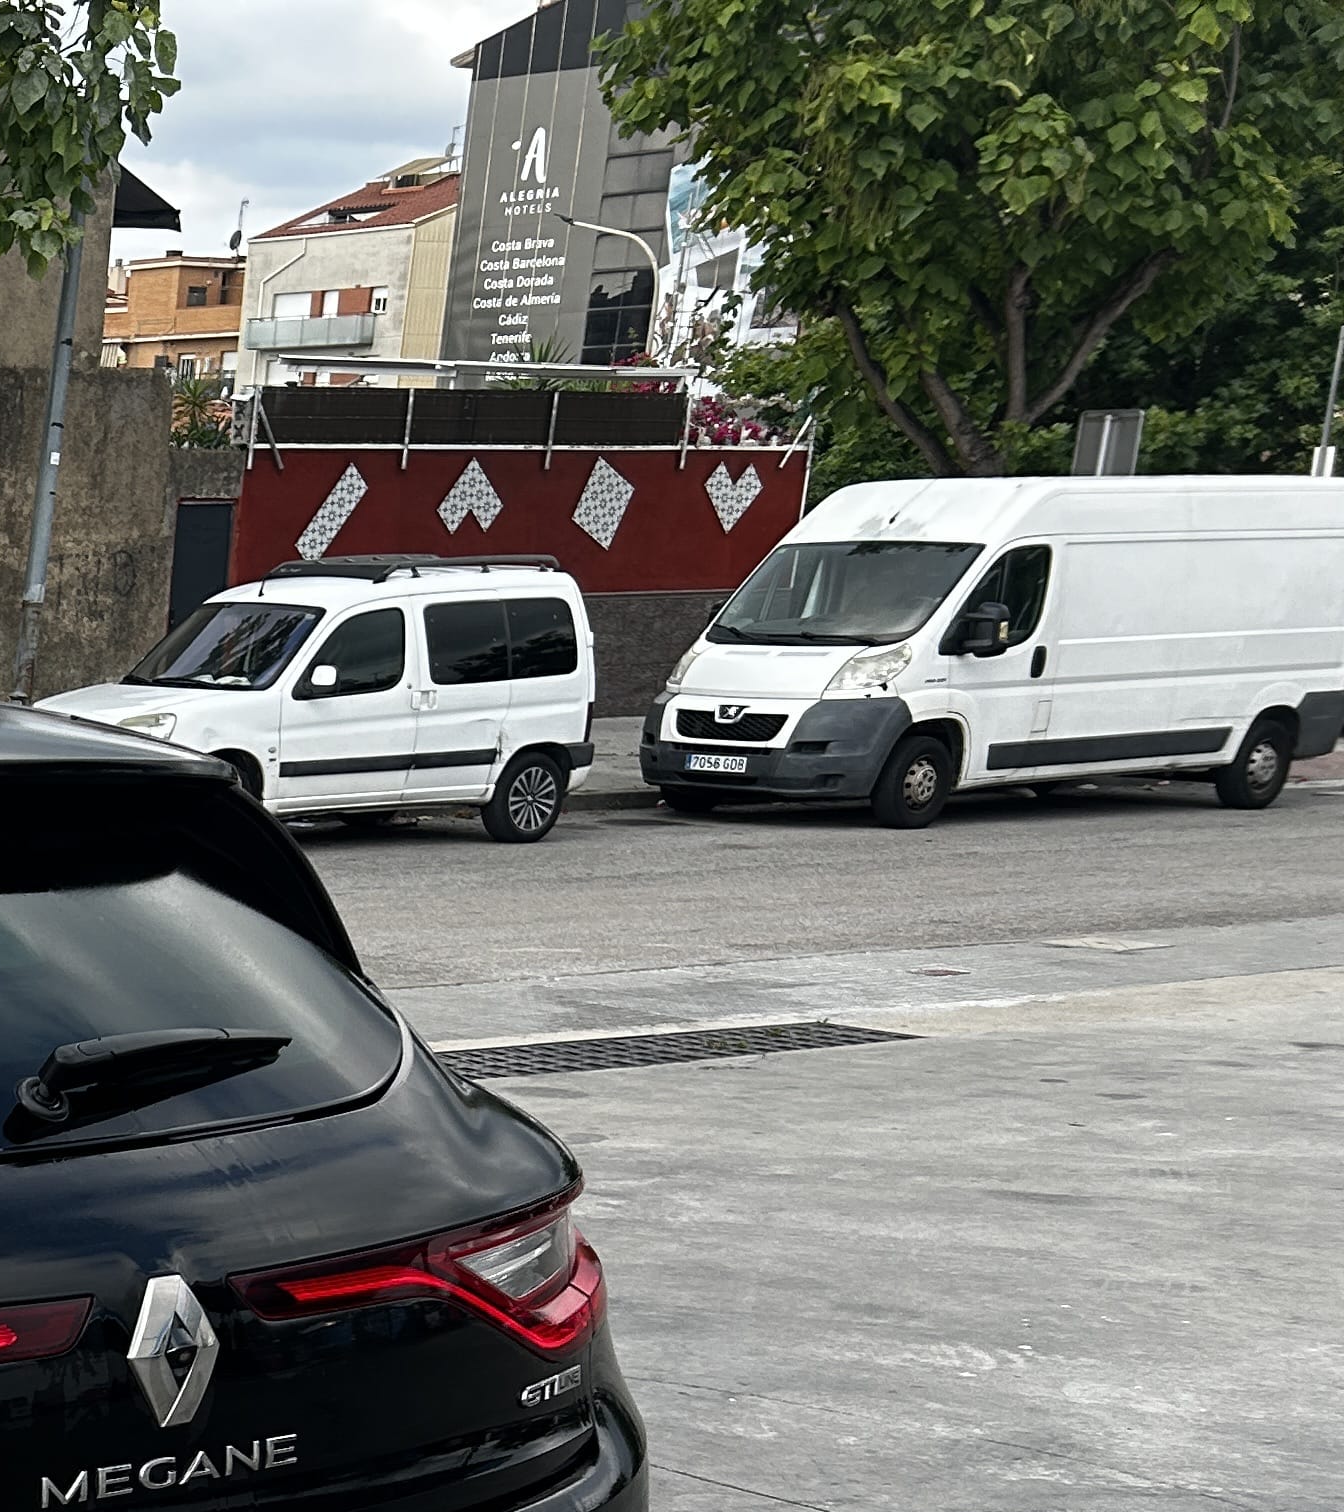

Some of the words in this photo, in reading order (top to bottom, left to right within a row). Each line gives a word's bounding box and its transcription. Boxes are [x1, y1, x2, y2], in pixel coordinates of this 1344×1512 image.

[499, 187, 560, 203] ALEGRIA
[505, 202, 552, 216] HOTELS
[492, 240, 522, 252] Costa
[524, 238, 555, 250] Brava
[480, 260, 510, 271] Costa
[512, 255, 566, 270] Barcelona
[484, 278, 514, 290] Costa
[516, 274, 554, 288] Dorada
[473, 297, 503, 309] Costa
[505, 295, 519, 306] de
[498, 313, 529, 326] Cádiz
[490, 331, 532, 345] Tenerife
[693, 755, 721, 769] 7056
[40, 1433, 298, 1509] MEGANE
